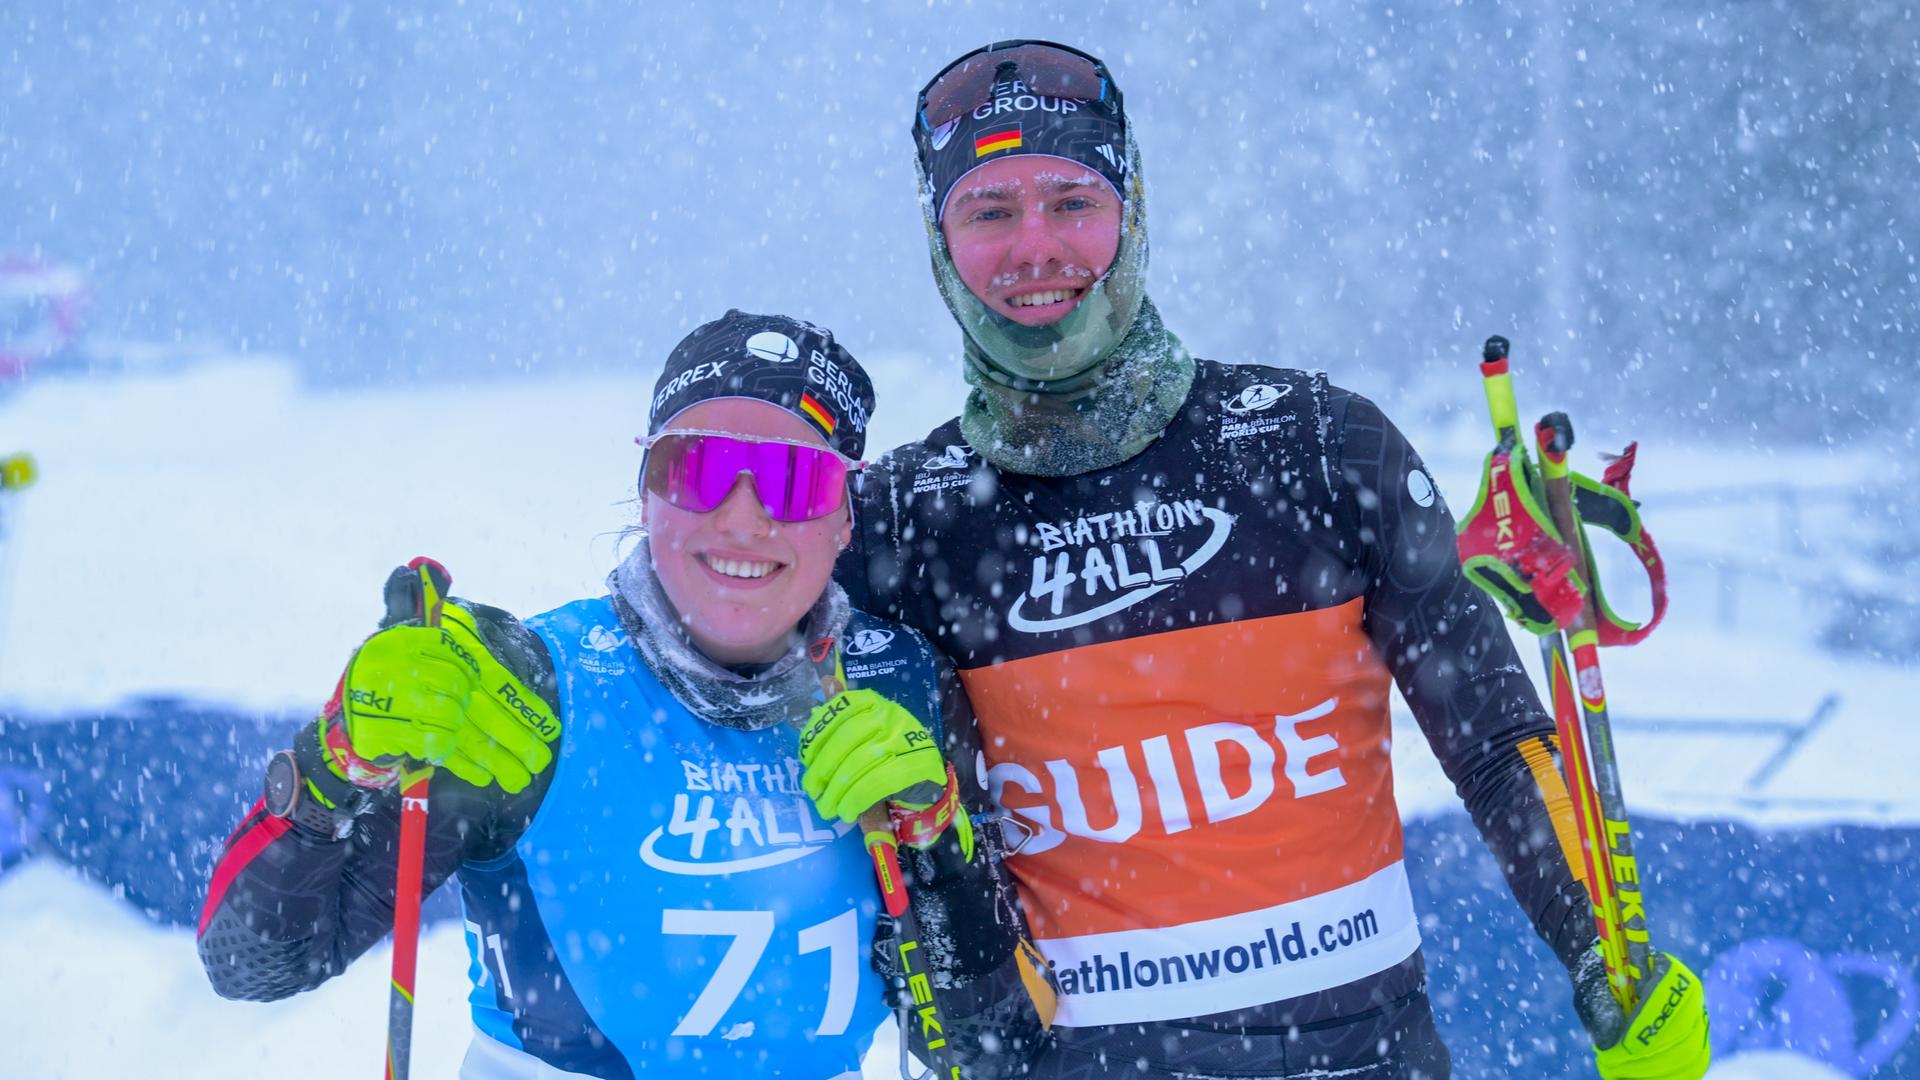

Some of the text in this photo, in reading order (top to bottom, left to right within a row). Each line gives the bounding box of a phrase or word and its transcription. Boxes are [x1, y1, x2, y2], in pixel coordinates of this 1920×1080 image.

[972, 95, 1078, 120] GROUP
[808, 366, 863, 433] GROUP
[1220, 425, 1281, 439] WORLD CUP
[1221, 414, 1296, 432] PARA BIATHLON
[912, 480, 974, 494] WORLD CUP
[913, 477, 941, 487] PARA
[1490, 464, 1515, 551] LEKI
[846, 658, 907, 673] PARA BIATHLON
[846, 667, 895, 679] WORLD CUP
[987, 698, 1348, 856] GUIDE
[1605, 818, 1649, 943] LEKI
[464, 919, 514, 999] 71
[661, 907, 860, 1037] 71
[1046, 907, 1379, 996] iathlonworld.com
[899, 940, 946, 1050] LEKI
